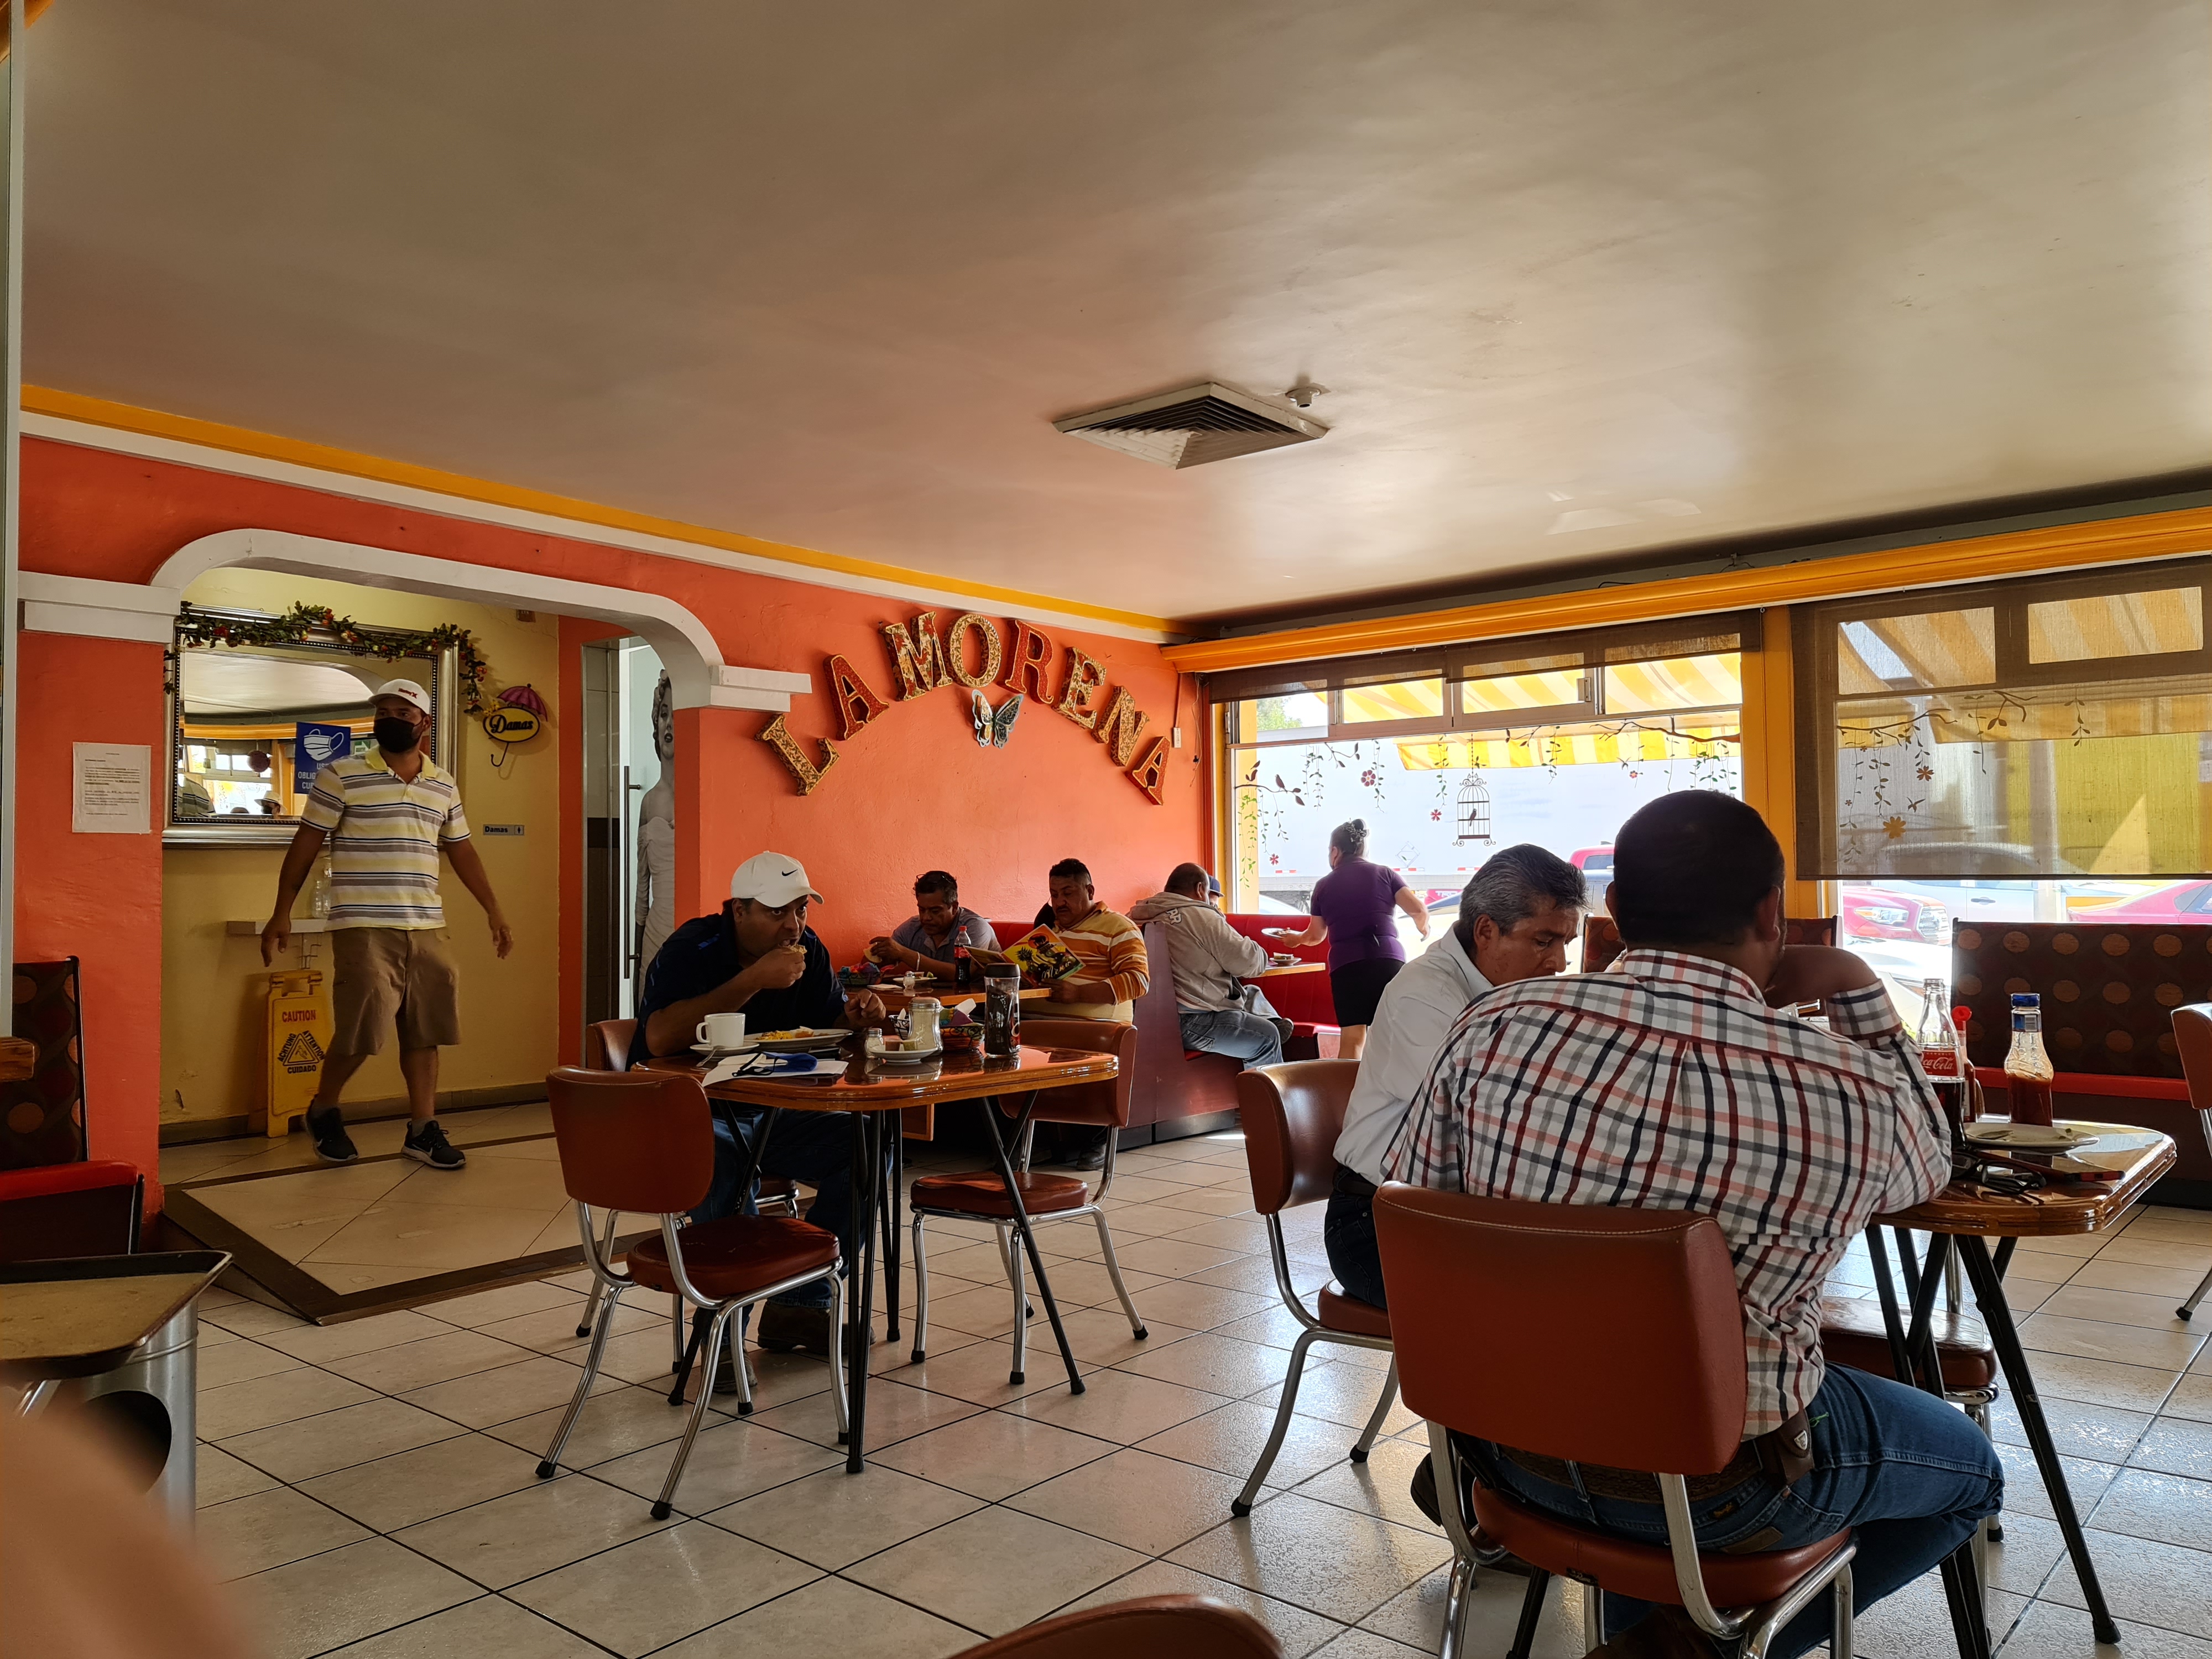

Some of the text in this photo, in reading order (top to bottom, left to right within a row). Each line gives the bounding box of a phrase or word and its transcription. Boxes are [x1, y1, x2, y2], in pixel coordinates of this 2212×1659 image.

[754, 611, 1170, 806] LA MORENA
[489, 714, 533, 733] Damas
[282, 1010, 316, 1022] CAUTION
[277, 1033, 296, 1062] ACHTUNG
[302, 1030, 325, 1060] ATTENTION
[288, 1065, 316, 1074] CUIDADO
